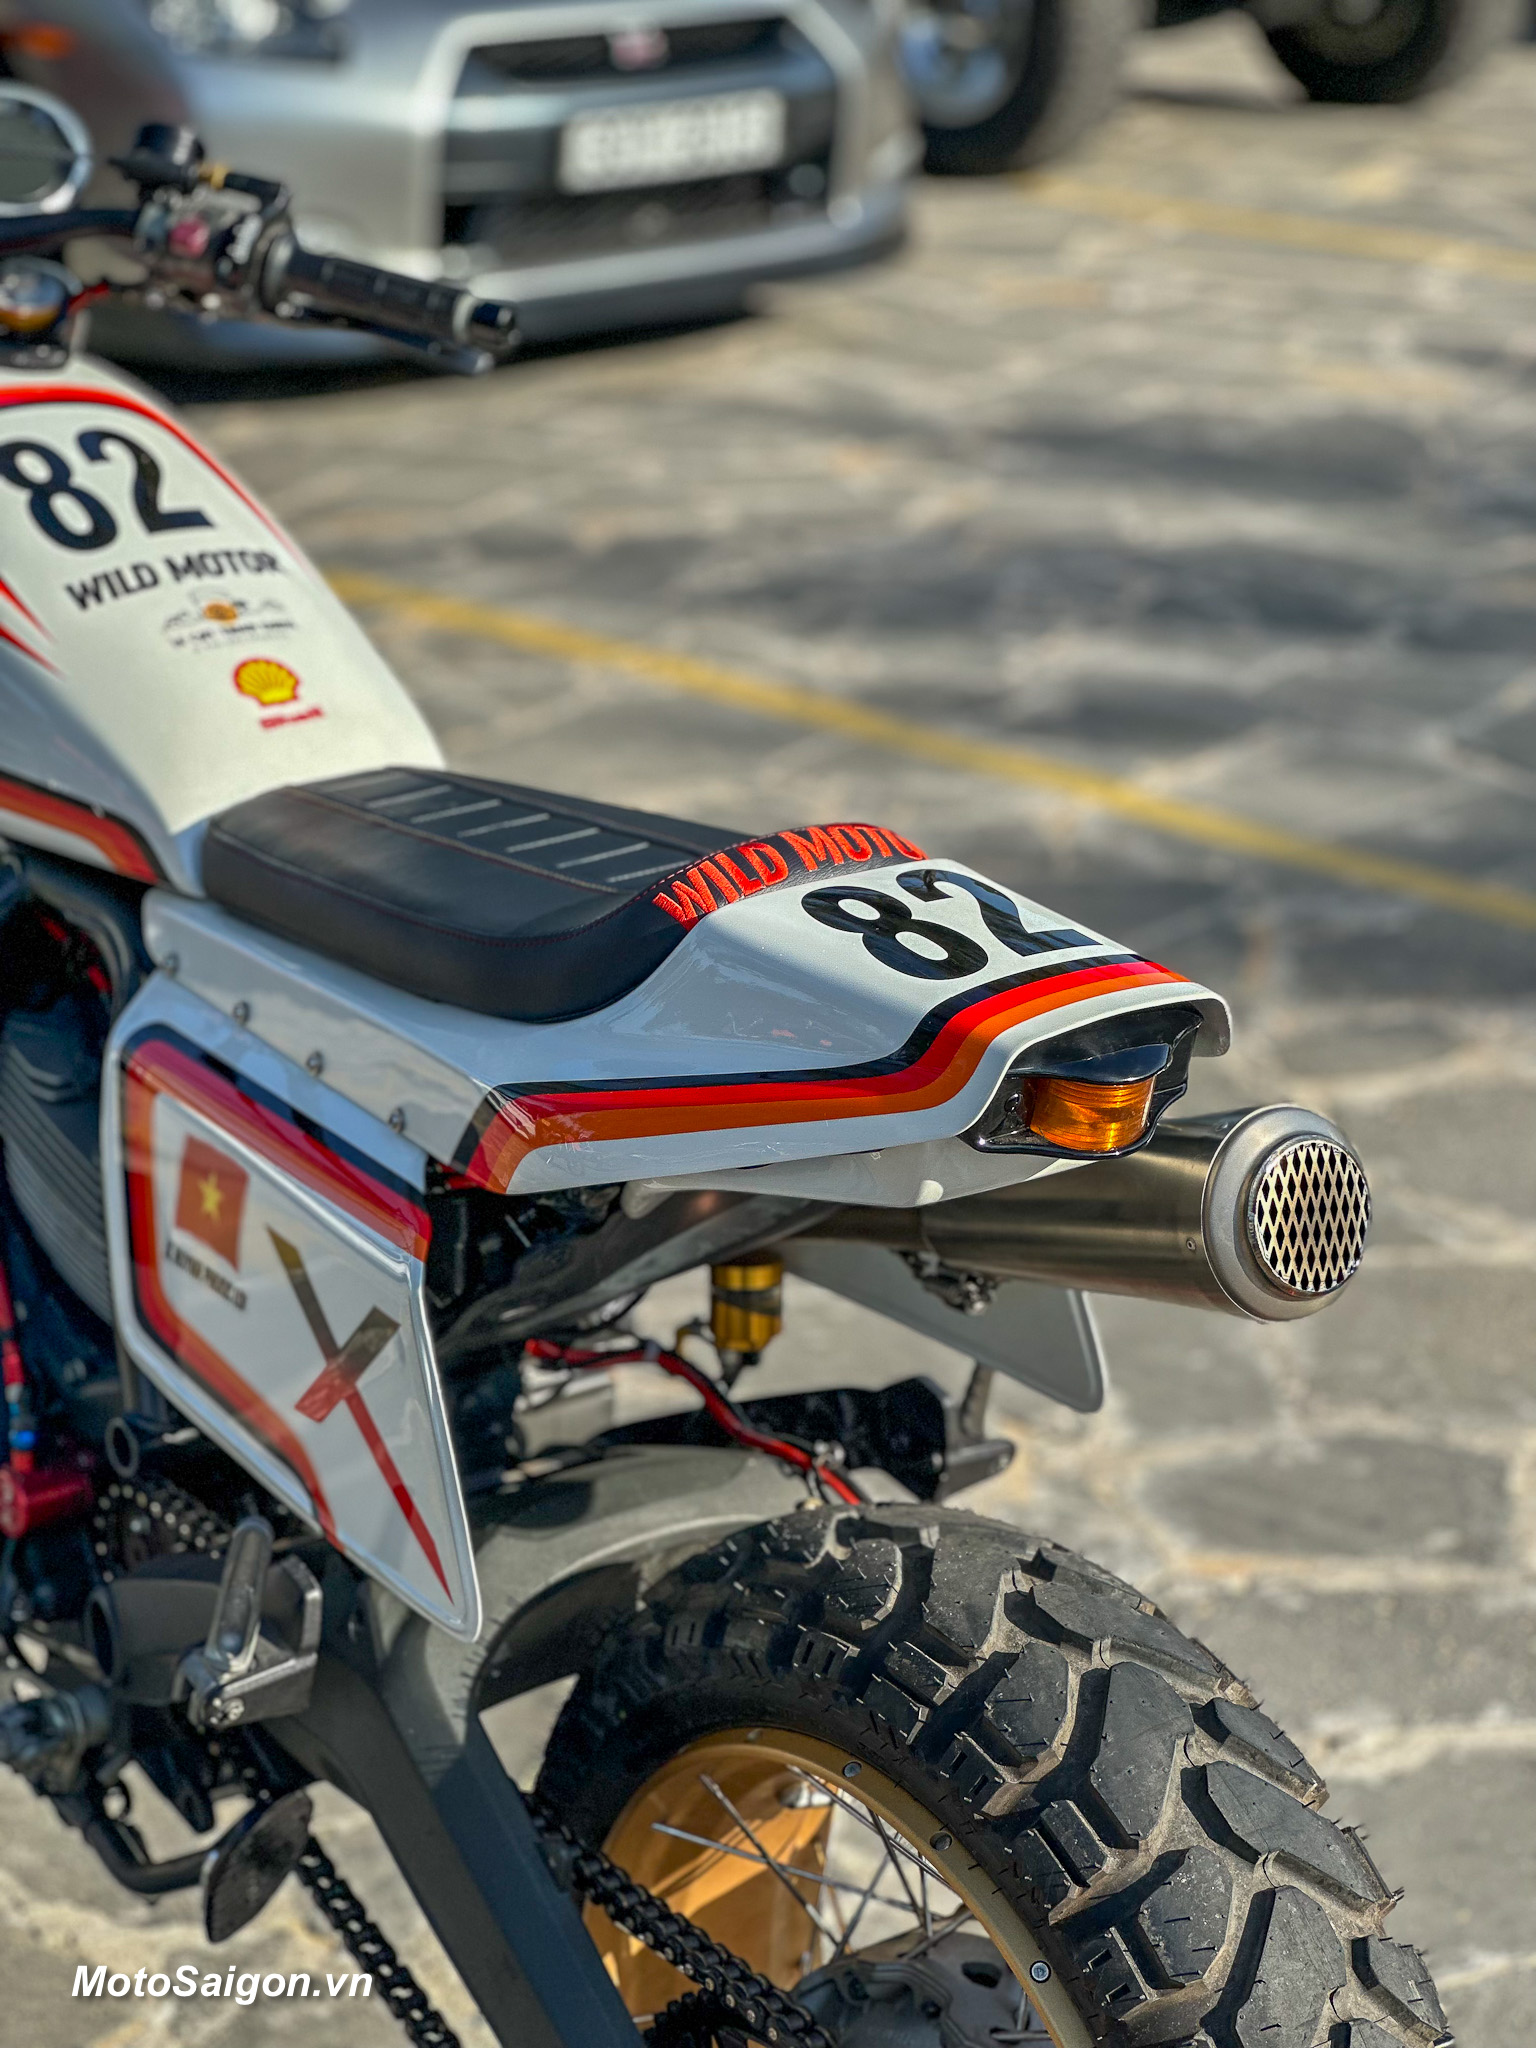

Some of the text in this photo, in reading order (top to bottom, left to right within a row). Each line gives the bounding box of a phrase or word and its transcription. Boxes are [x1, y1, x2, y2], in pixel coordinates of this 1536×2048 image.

[0, 430, 215, 551] 82
[65, 550, 282, 612] WILD MOTOR
[651, 841, 789, 932] WILD
[801, 868, 1104, 980] 82
